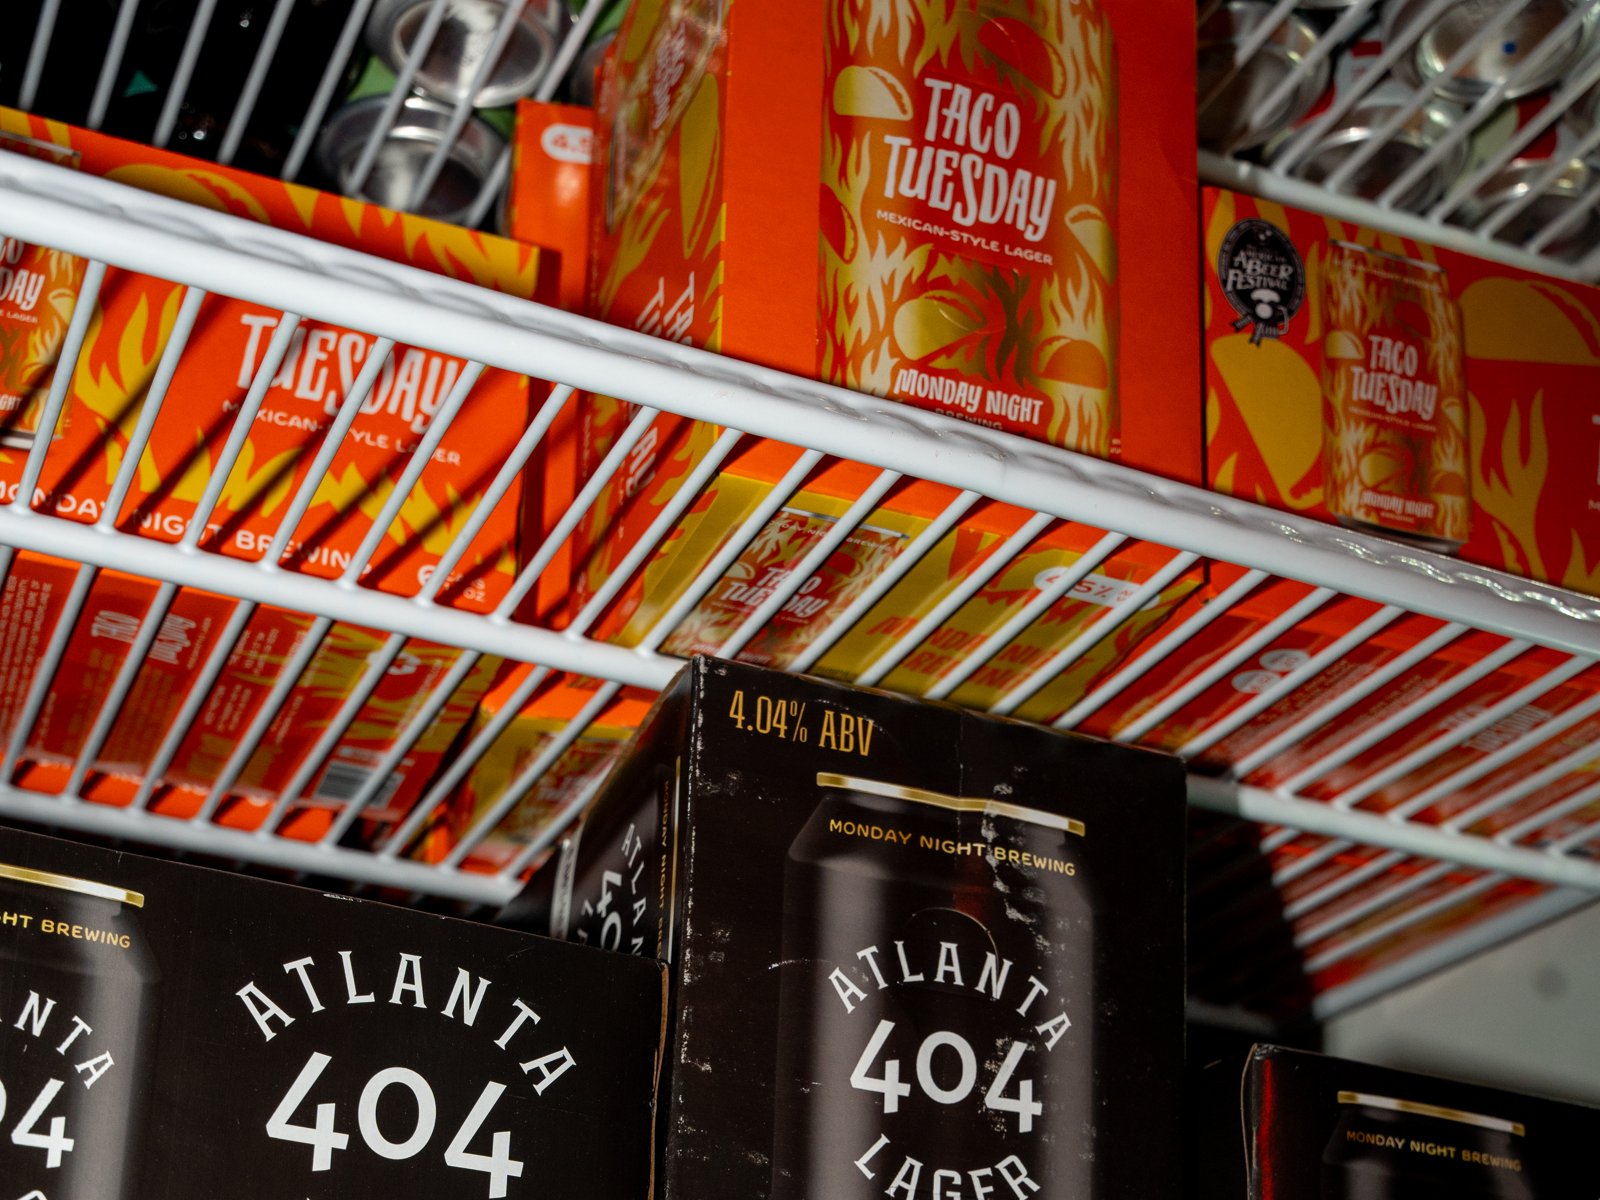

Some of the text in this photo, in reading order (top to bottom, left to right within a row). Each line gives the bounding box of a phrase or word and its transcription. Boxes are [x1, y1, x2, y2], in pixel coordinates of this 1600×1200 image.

[924, 77, 1021, 160] TACO
[884, 135, 1057, 242] TUESDAY
[876, 209, 1053, 266] MEXICAN-STYLE LAGER
[1369, 335, 1418, 377] TACO
[893, 368, 1044, 425] MONDAY NIGHT
[1350, 366, 1438, 421] TUESDAY
[729, 690, 874, 757] 4.04% ABV
[829, 819, 1076, 877] MONDAY NIGHT BREWING
[41, 919, 131, 948] BREWING
[236, 951, 577, 1096] ATLANTA
[828, 940, 1073, 1052] ATLANTA
[849, 1019, 1043, 1133] 404
[265, 1051, 525, 1199] 404
[1346, 1130, 1522, 1172] MONDAY NIGHT BREWING
